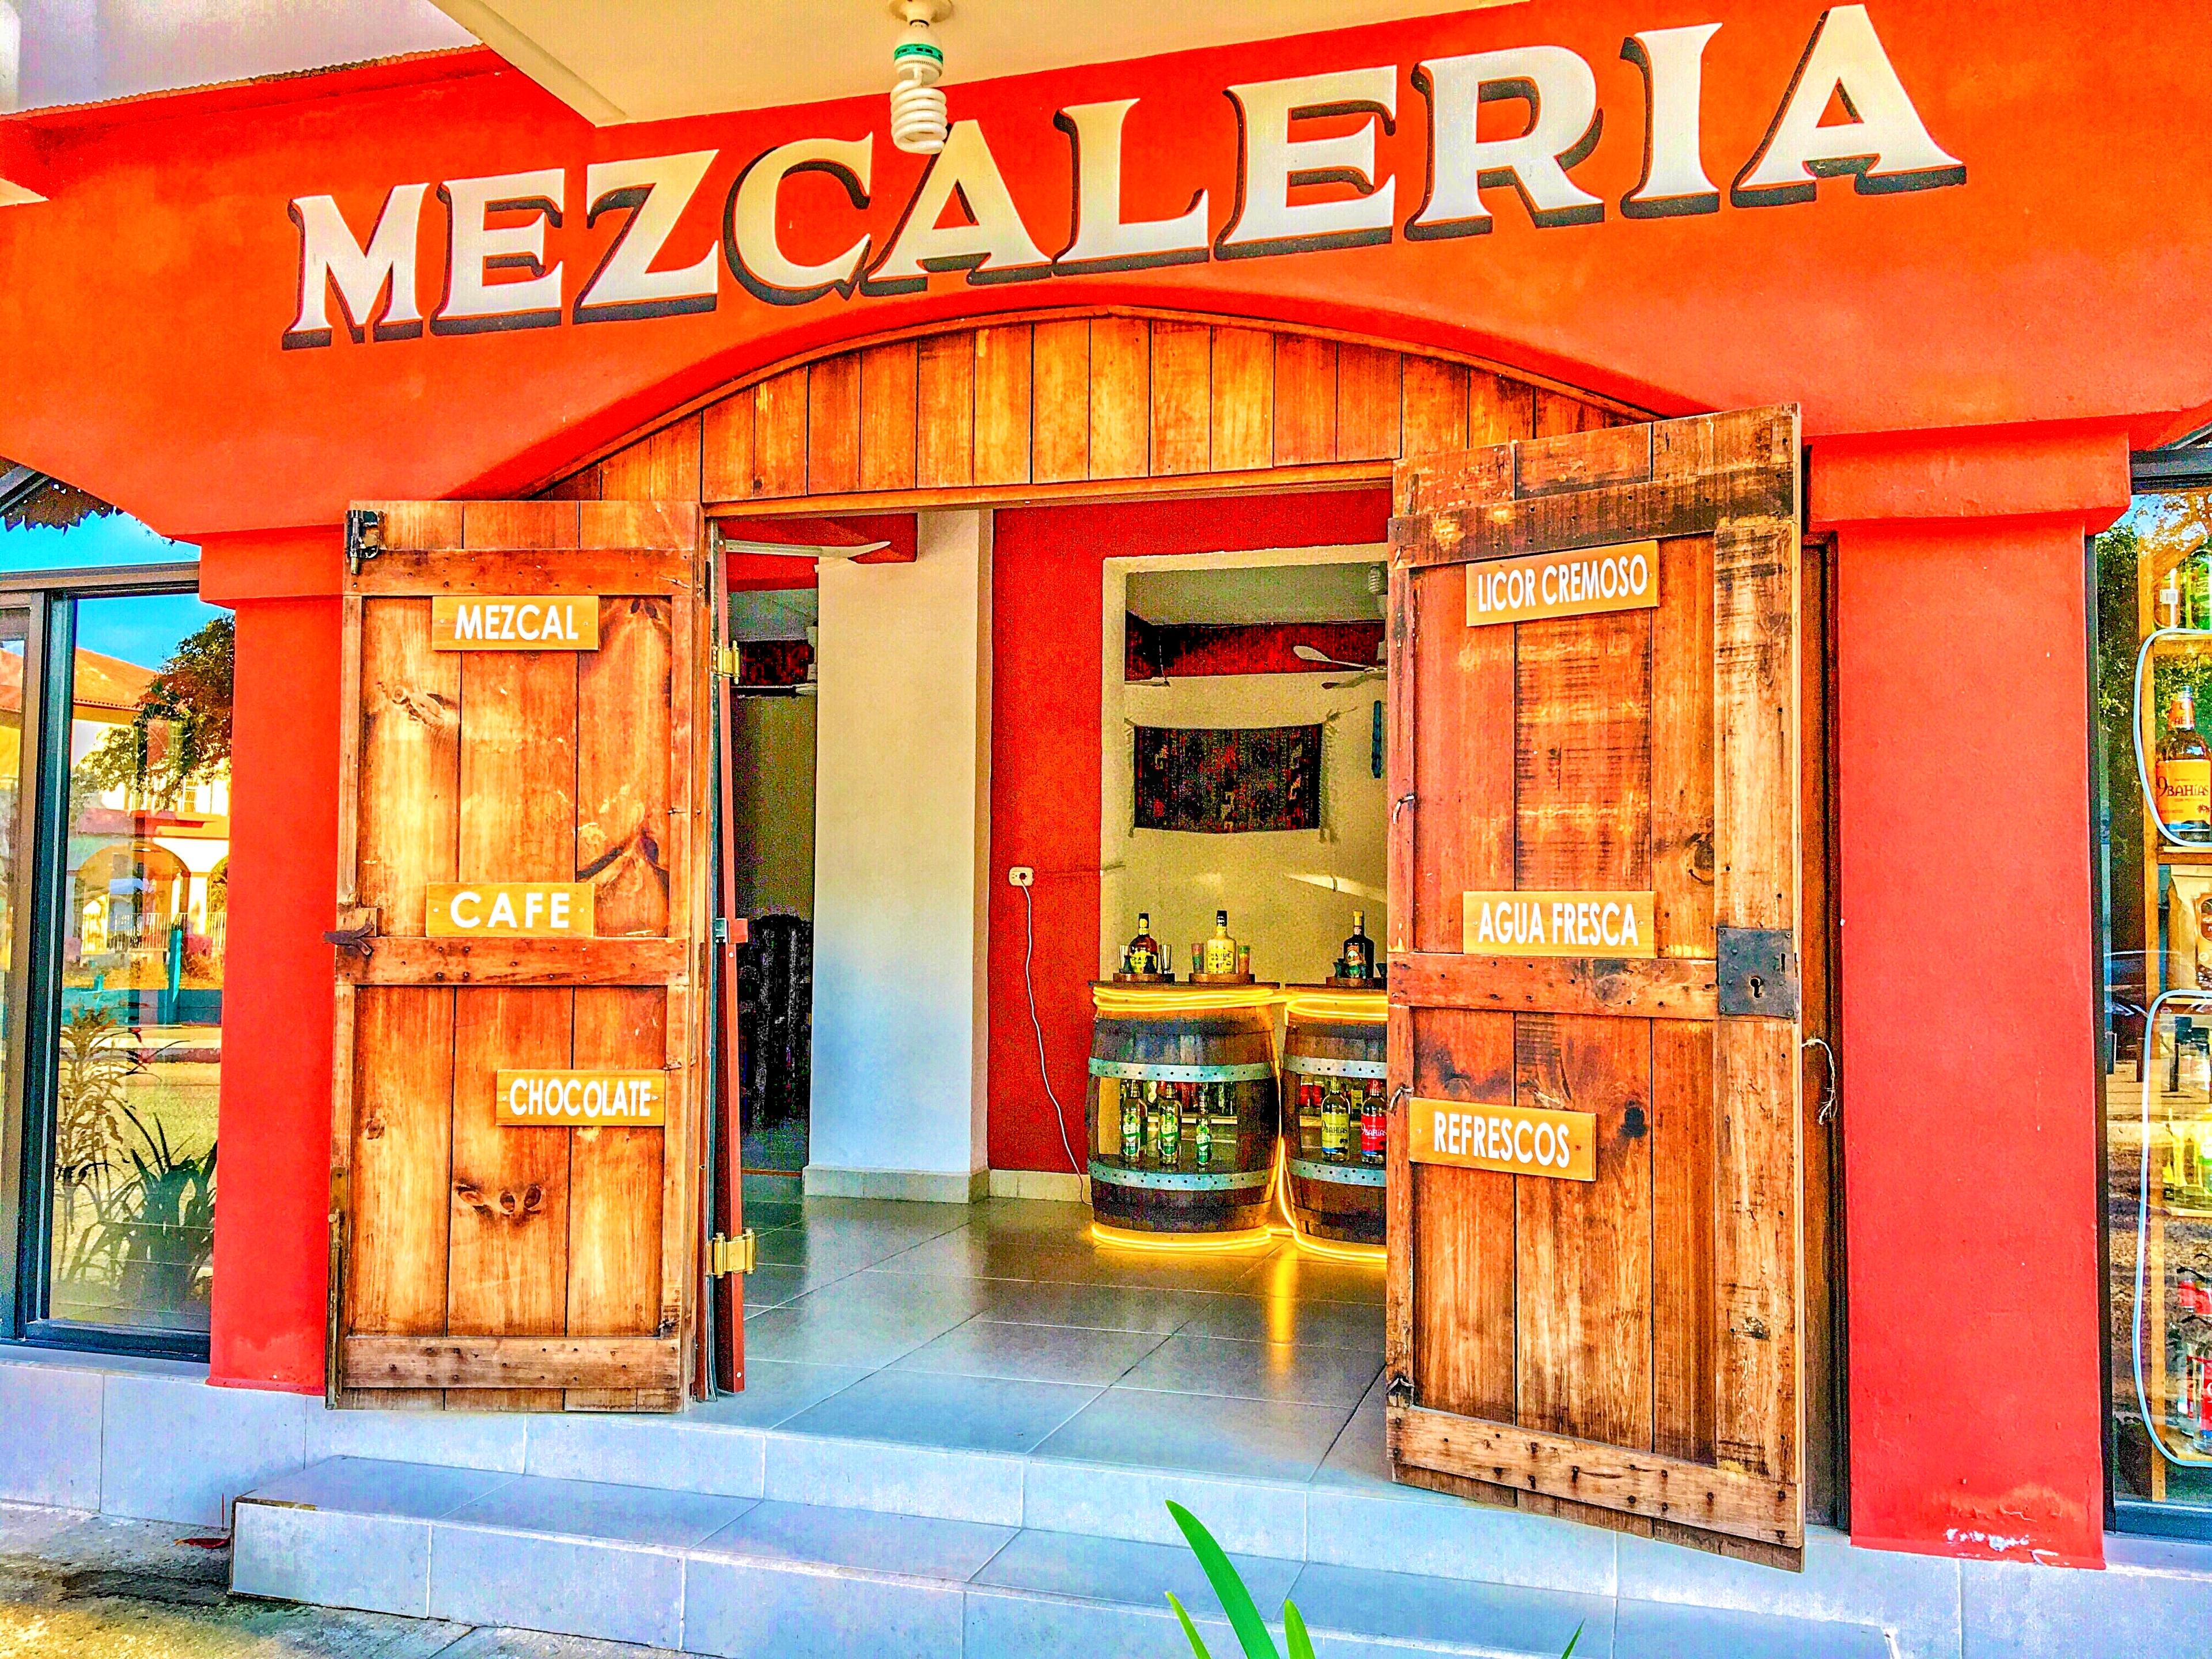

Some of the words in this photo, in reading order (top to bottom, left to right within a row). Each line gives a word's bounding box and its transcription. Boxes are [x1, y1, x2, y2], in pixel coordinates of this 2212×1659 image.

[284, 3, 1965, 347] MEZCALERIA
[1478, 569, 1536, 612] LICOR
[1541, 554, 1647, 605] CREMOSO
[454, 604, 579, 641] MEZCAL
[450, 891, 569, 928] CAFE
[1478, 902, 1545, 944] AGUA
[1552, 902, 1639, 946] FRESCA
[510, 1078, 651, 1118] CHOCOLATE
[1434, 1111, 1570, 1168] REFRESCOS
